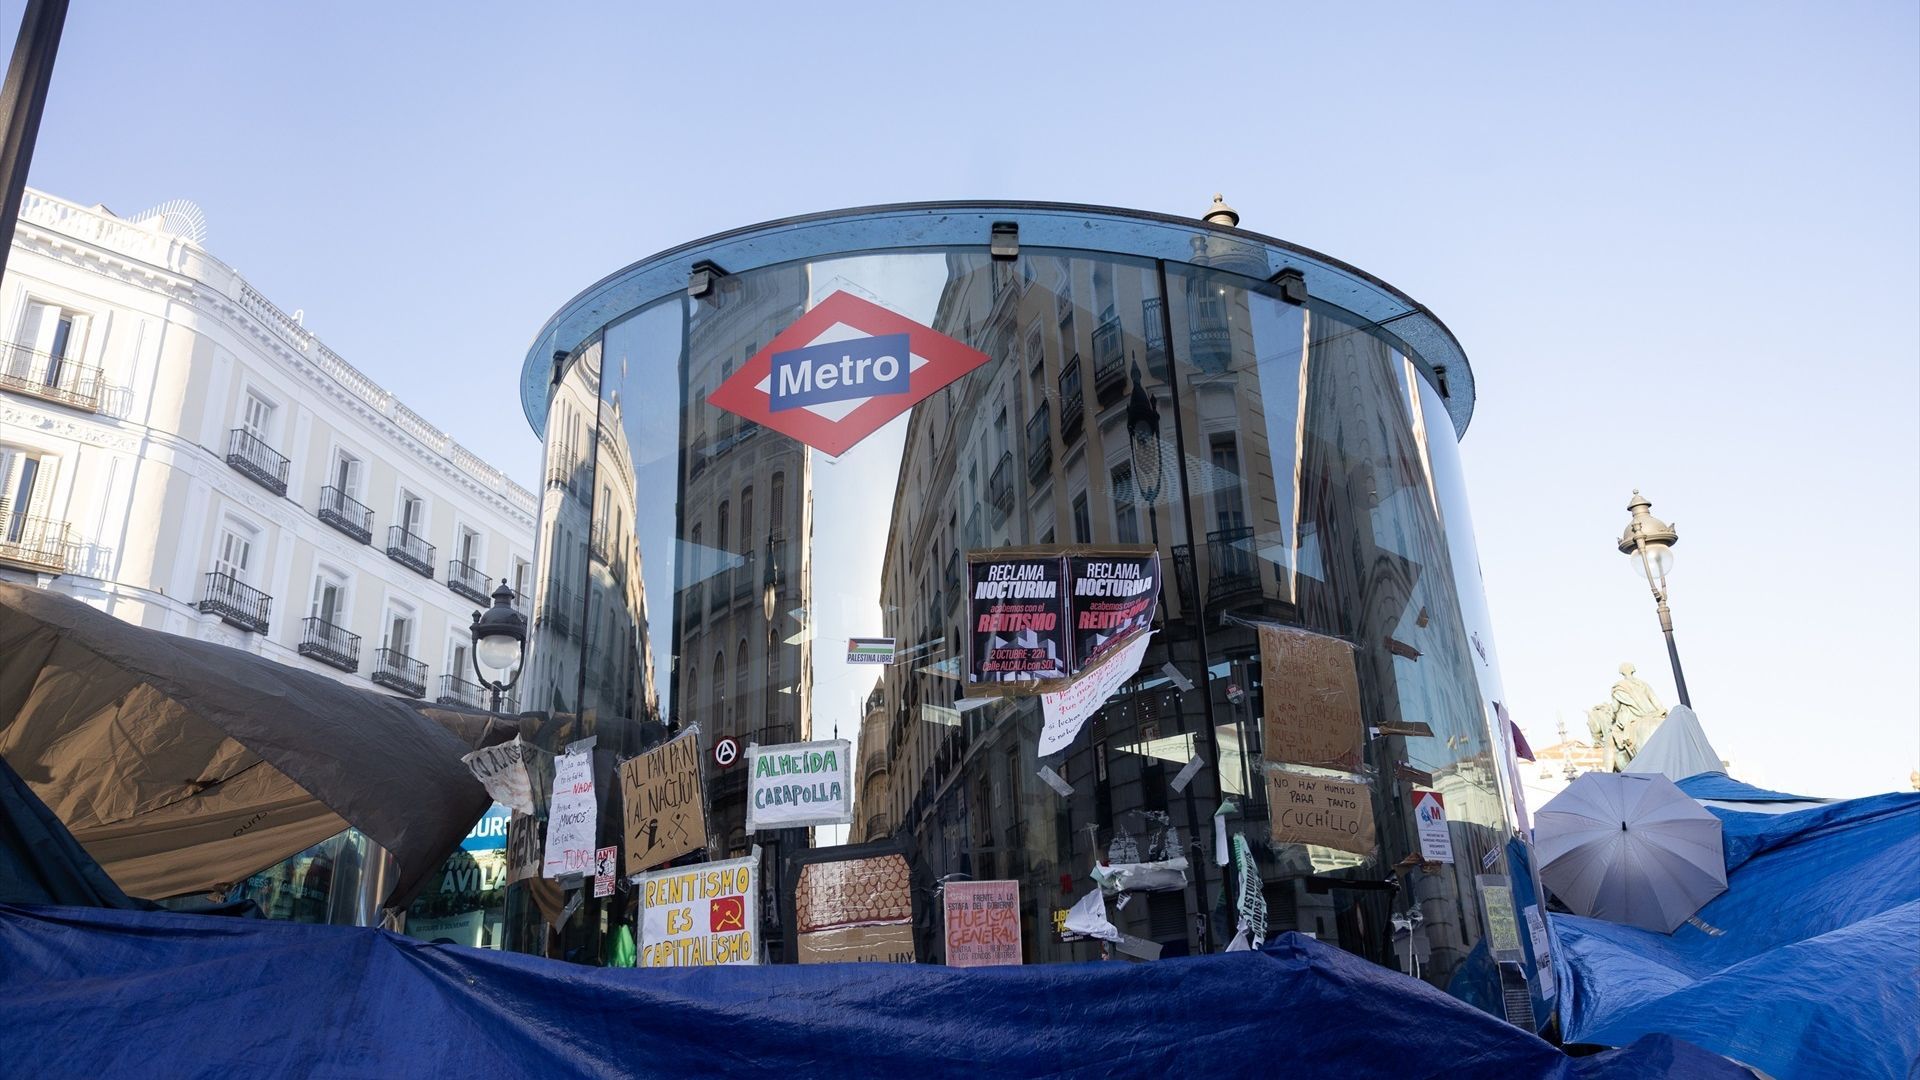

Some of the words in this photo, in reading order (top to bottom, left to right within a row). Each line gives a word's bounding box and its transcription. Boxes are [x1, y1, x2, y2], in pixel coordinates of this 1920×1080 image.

[778, 354, 899, 397] Metro
[988, 565, 1044, 581] RECLAMA
[1087, 563, 1140, 579] RECLAMA
[975, 581, 1057, 599] NOCTURNA
[1075, 576, 1152, 596] NOCTURNA
[990, 603, 1023, 613] acabemos
[1025, 604, 1037, 612] con
[1038, 603, 1044, 612] el
[1078, 598, 1150, 629] RENTISMO
[1090, 601, 1123, 611] acabemos
[978, 613, 1057, 632] RENTISMO
[848, 654, 876, 662] PALESTINA
[877, 654, 892, 662] LIBRE
[996, 649, 1027, 659] OCTUBRE
[1032, 649, 1045, 659] 22h
[982, 661, 1000, 671] Calle
[1000, 659, 1026, 670] ALCALÁ
[1027, 662, 1041, 670] con
[1041, 659, 1055, 669] SOL
[625, 760, 646, 796] AL
[669, 736, 694, 774] PAN
[572, 781, 592, 796] NADA
[755, 781, 842, 809] CARAPOLLA
[1274, 778, 1288, 788] NO
[1299, 780, 1316, 791] HAY
[1325, 784, 1355, 795] HUMMUS
[1289, 790, 1314, 804] PARA
[1327, 797, 1356, 809] TANTO
[633, 794, 650, 825] AL
[563, 849, 589, 870] TODO
[646, 866, 749, 909] RENTISMO
[948, 902, 968, 910] ESTAFA
[973, 902, 983, 910] DEL
[667, 907, 694, 935] ES
[948, 906, 1018, 929] HUELGA
[948, 927, 1018, 949] GENERAL
[642, 931, 752, 967] CAPITALISMO
